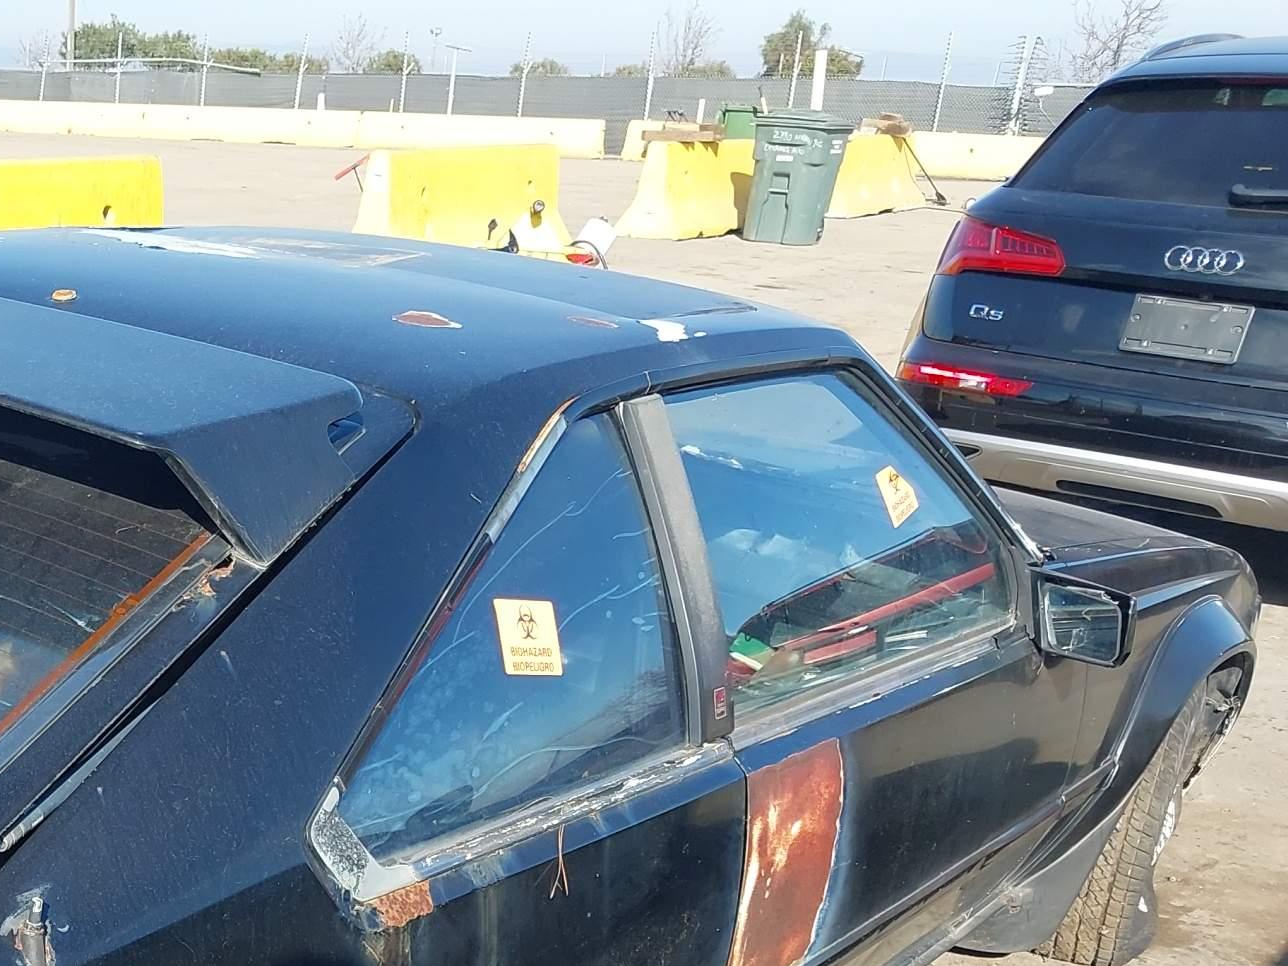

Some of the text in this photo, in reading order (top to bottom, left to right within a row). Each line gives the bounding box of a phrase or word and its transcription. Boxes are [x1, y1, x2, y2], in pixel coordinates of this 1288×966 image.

[968, 304, 1004, 321] Q5
[510, 646, 553, 657] BIOHAZARD
[512, 661, 555, 672] BIOPELIGRO
